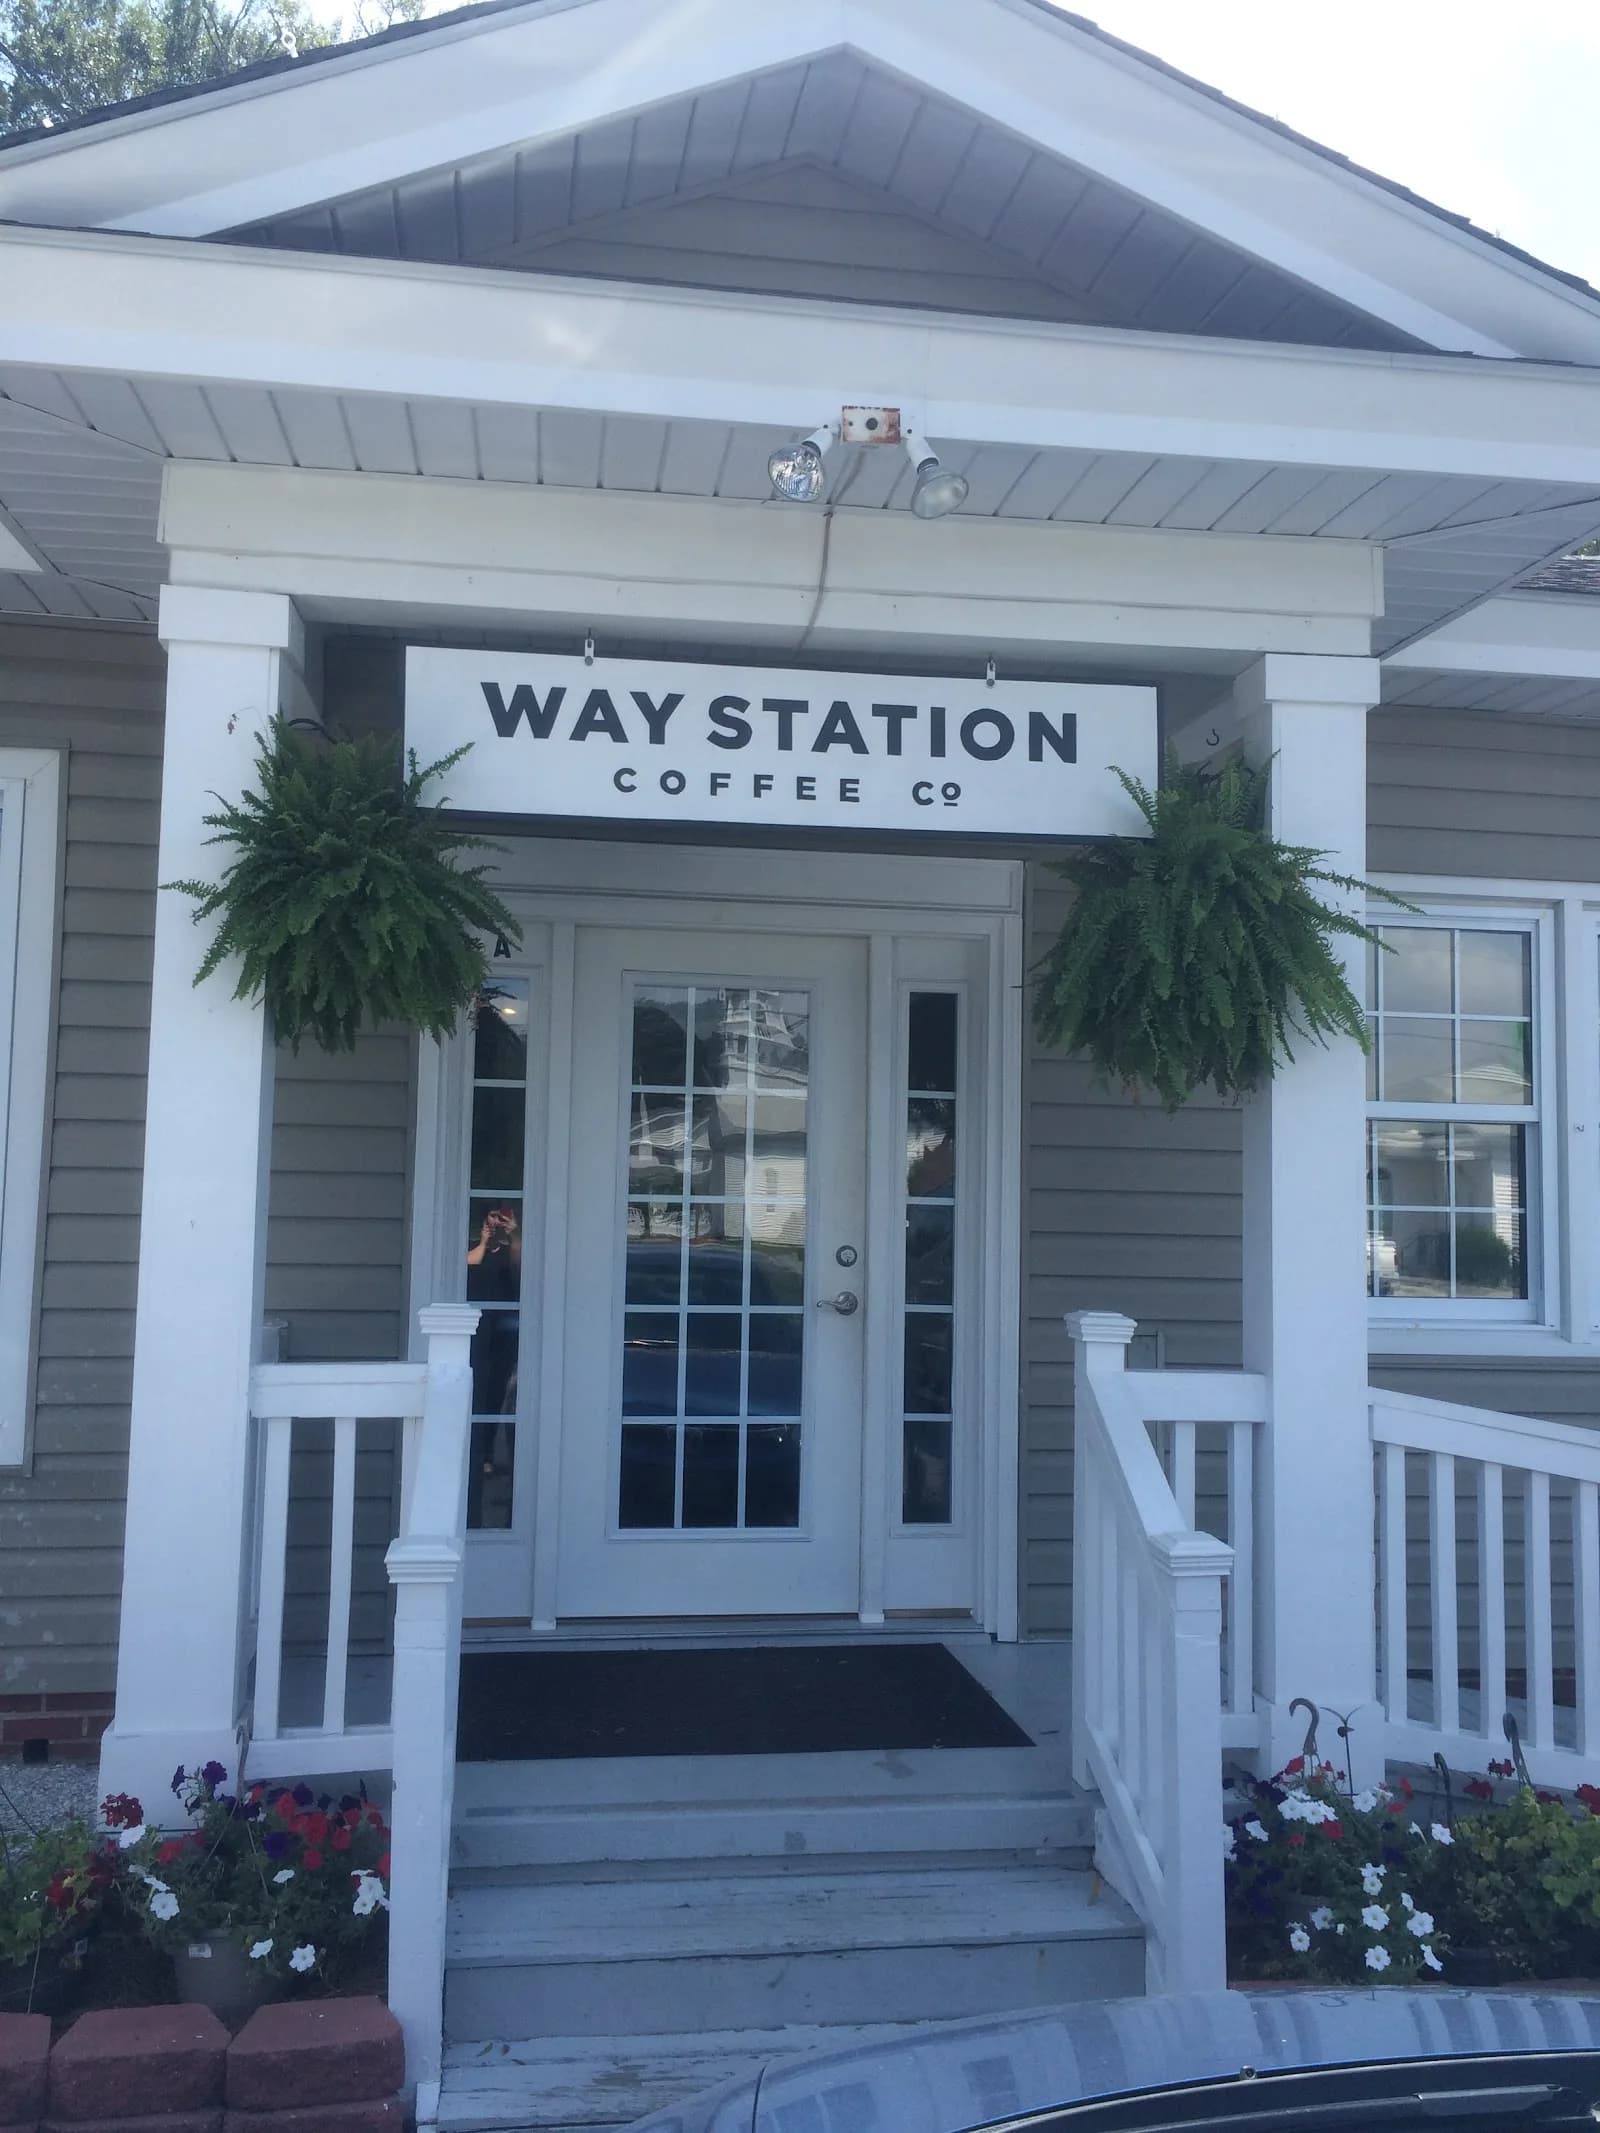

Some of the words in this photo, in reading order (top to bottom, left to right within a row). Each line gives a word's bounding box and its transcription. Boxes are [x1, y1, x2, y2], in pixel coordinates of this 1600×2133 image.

[480, 681, 685, 749] WAY
[706, 694, 1078, 765] STATION
[613, 767, 861, 803] COFFEE
